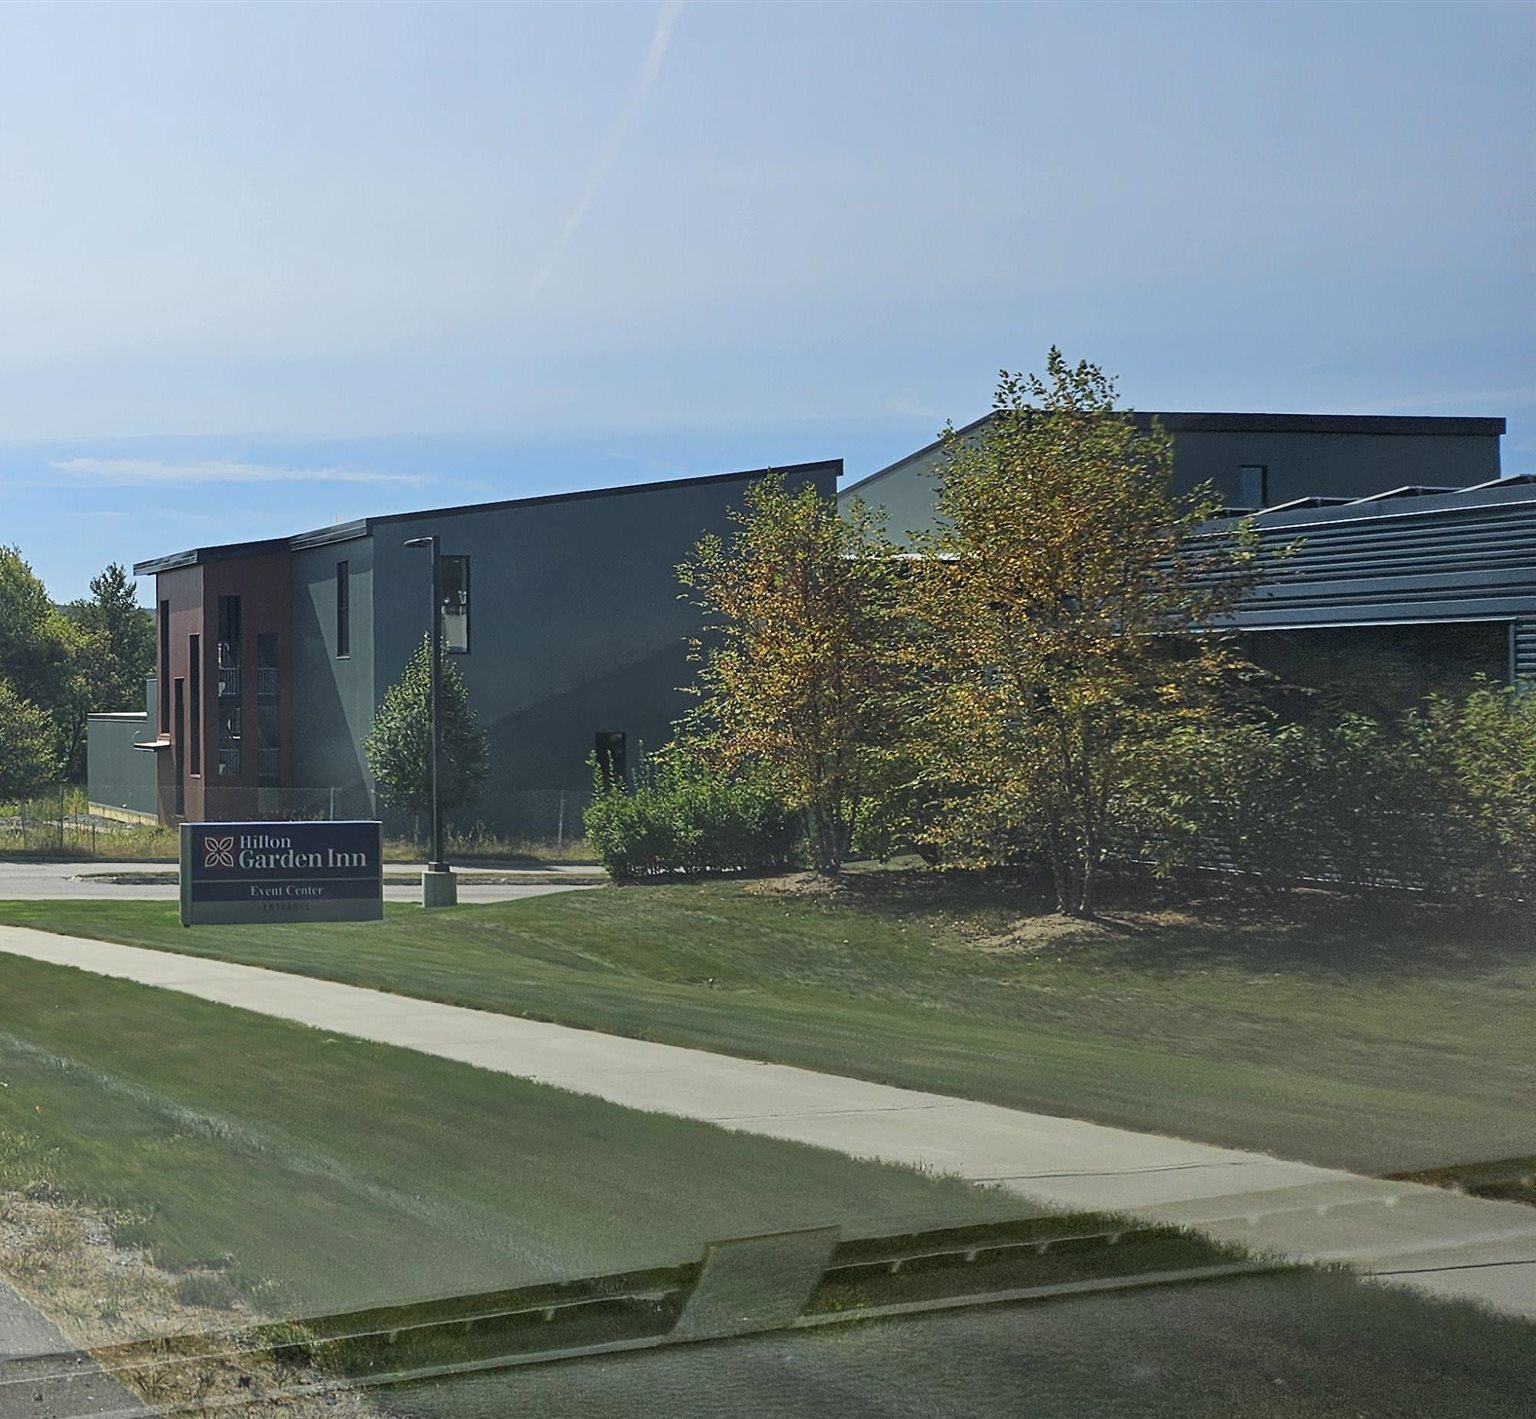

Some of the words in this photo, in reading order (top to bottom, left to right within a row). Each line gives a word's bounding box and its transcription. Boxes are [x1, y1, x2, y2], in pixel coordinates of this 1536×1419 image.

[240, 835, 291, 849] Hilton
[239, 849, 323, 869] Garden
[327, 848, 367, 867] Inn
[250, 885, 282, 896] Event
[286, 885, 324, 896] Center
